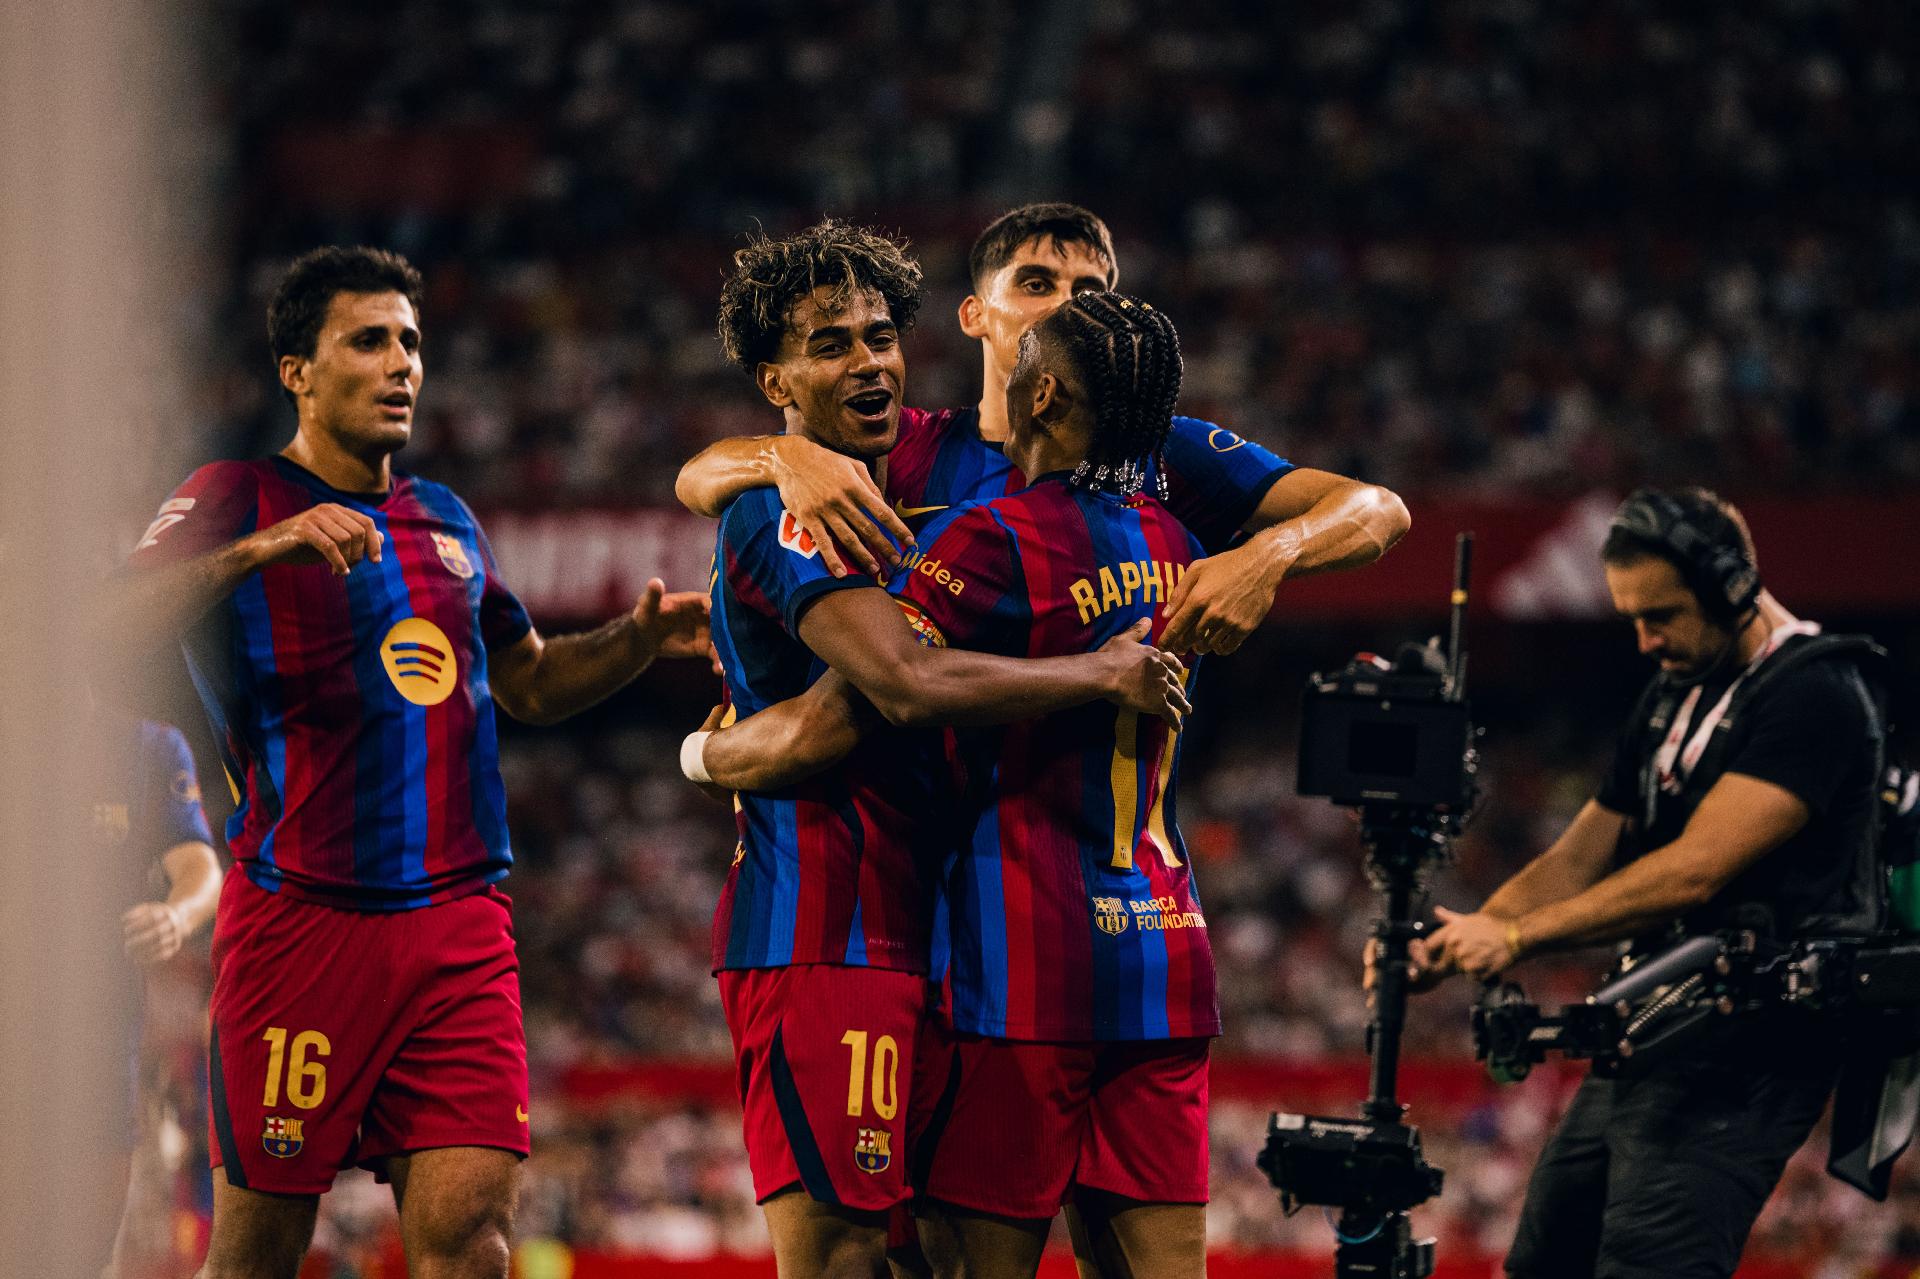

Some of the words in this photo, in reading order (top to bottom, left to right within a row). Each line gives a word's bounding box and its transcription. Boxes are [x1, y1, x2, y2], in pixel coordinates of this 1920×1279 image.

[1111, 668, 1189, 869] 11
[1129, 896, 1178, 914] BARÇA
[262, 1027, 331, 1109] 16
[841, 1030, 899, 1120] 10
